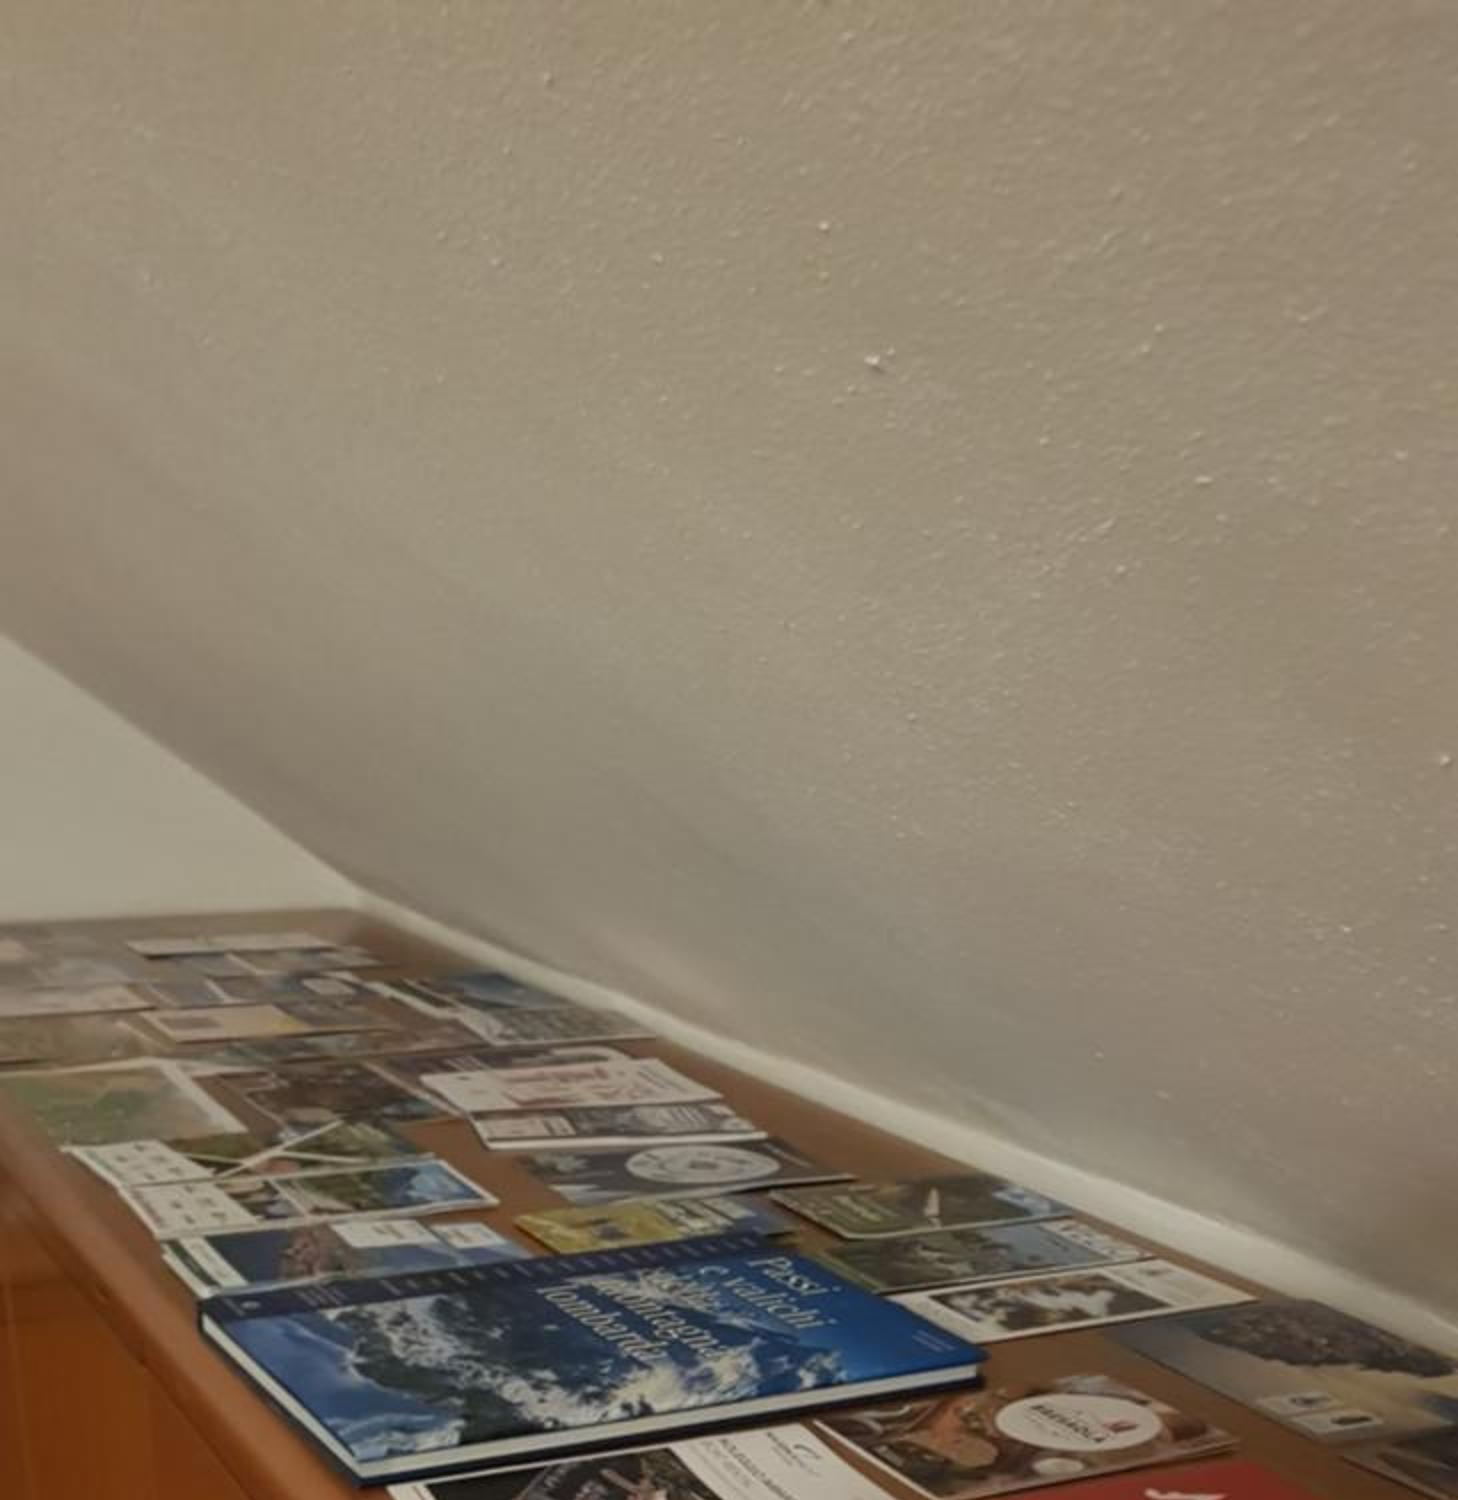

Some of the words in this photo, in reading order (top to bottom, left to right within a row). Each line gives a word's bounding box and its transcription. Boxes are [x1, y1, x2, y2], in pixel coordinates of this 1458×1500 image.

[699, 1265, 730, 1279] e
[722, 1277, 839, 1329] valichi
[747, 1256, 842, 1296] Passi
[536, 1284, 668, 1361] lombarda
